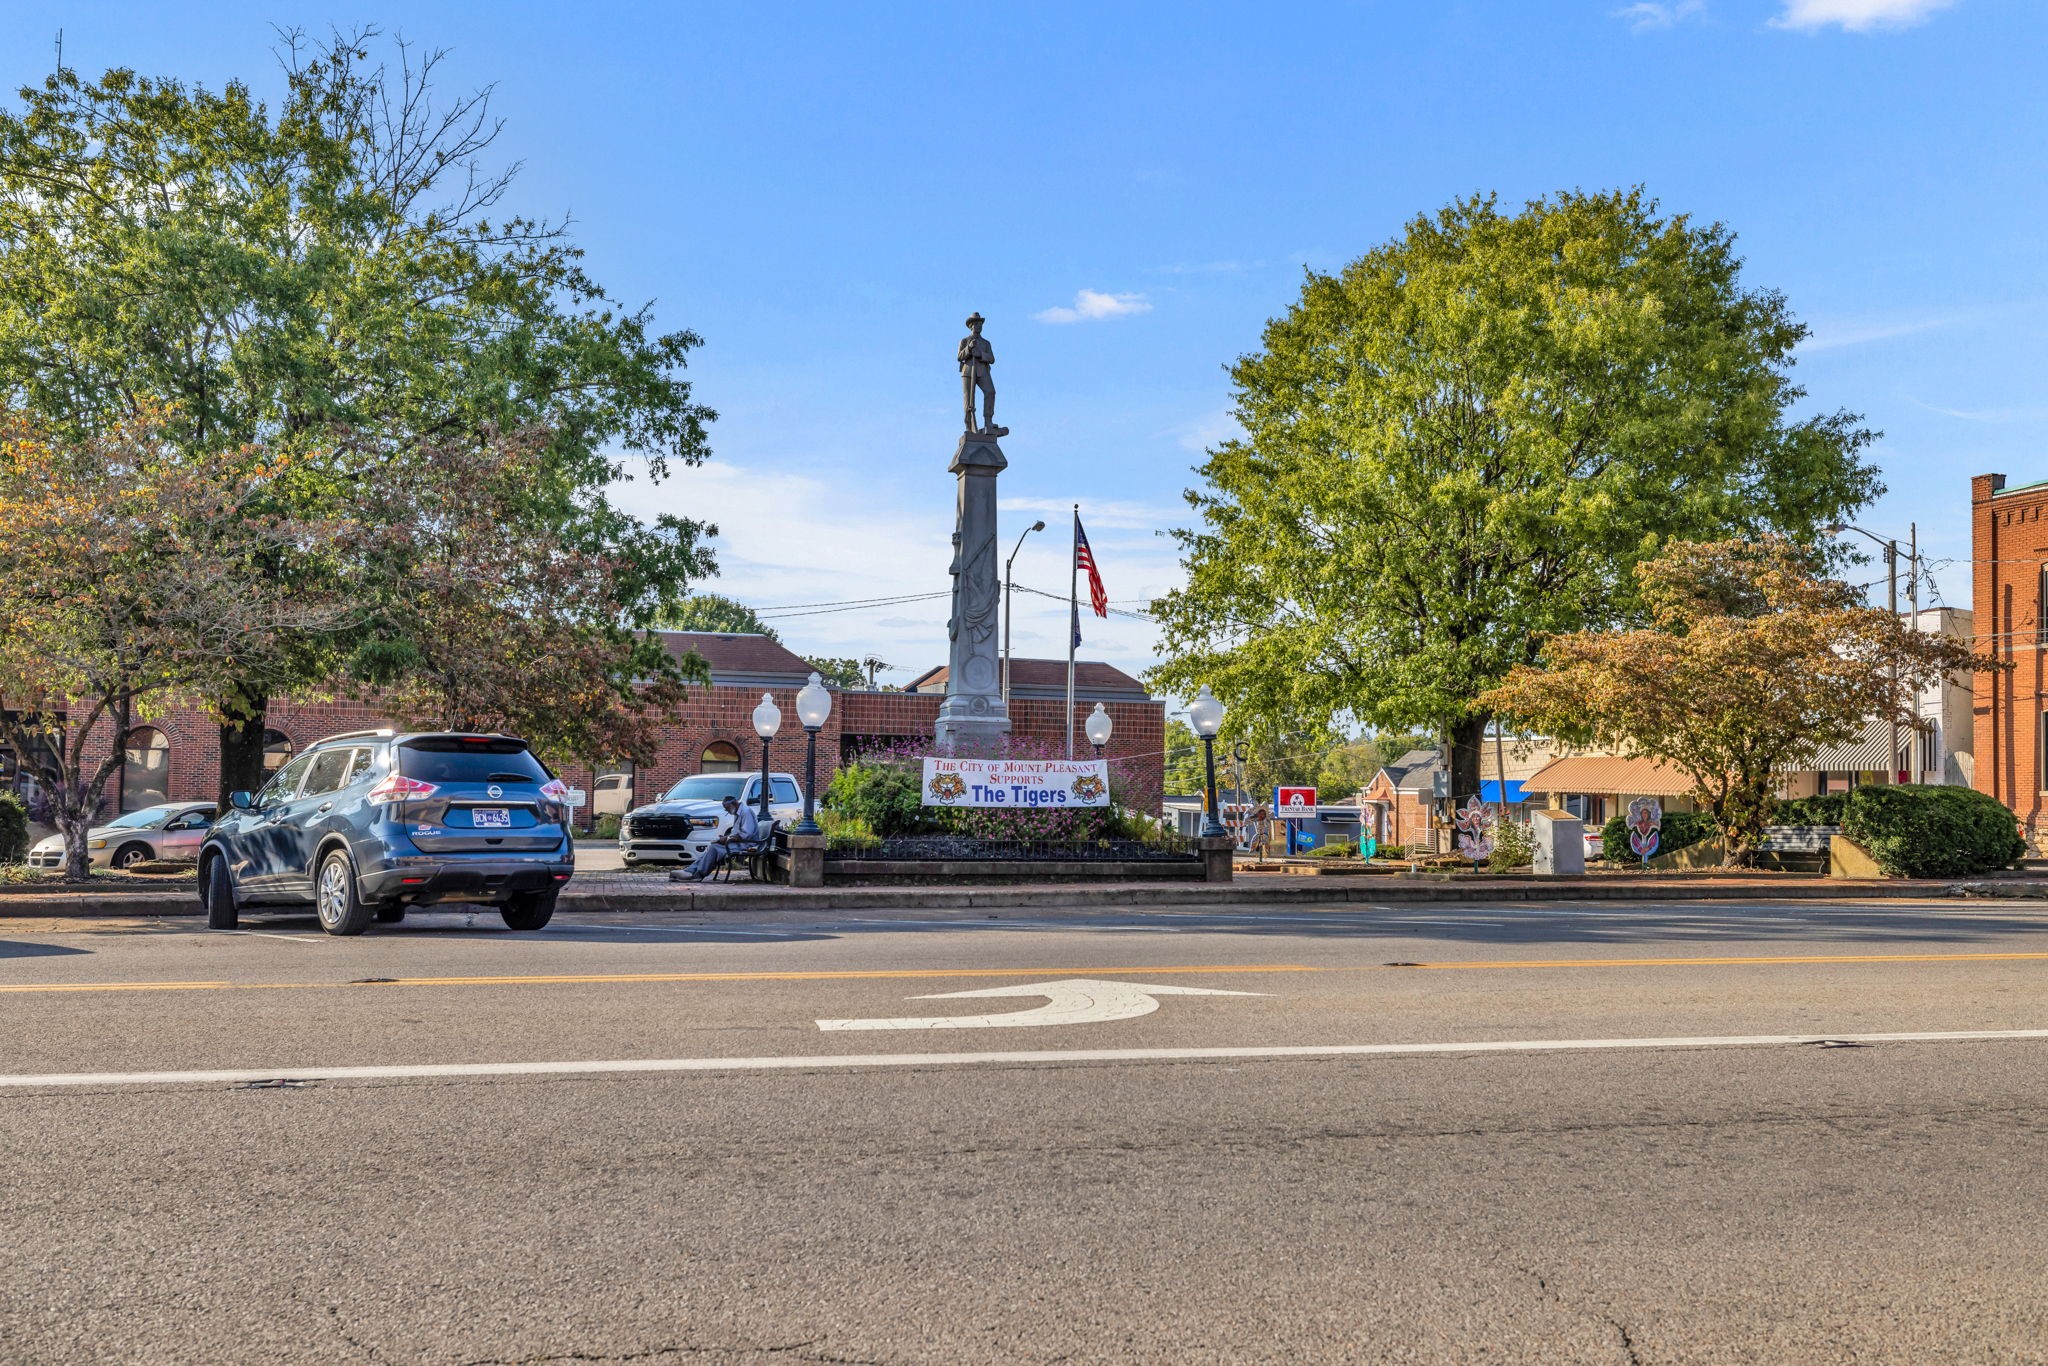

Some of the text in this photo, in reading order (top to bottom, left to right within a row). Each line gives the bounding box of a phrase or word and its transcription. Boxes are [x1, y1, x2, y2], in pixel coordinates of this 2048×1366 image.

[935, 760, 1097, 773] THE CITY OF MOUNT PLEASANT
[989, 774, 1044, 785] SUPPORTS
[972, 785, 1067, 807] The Tigers
